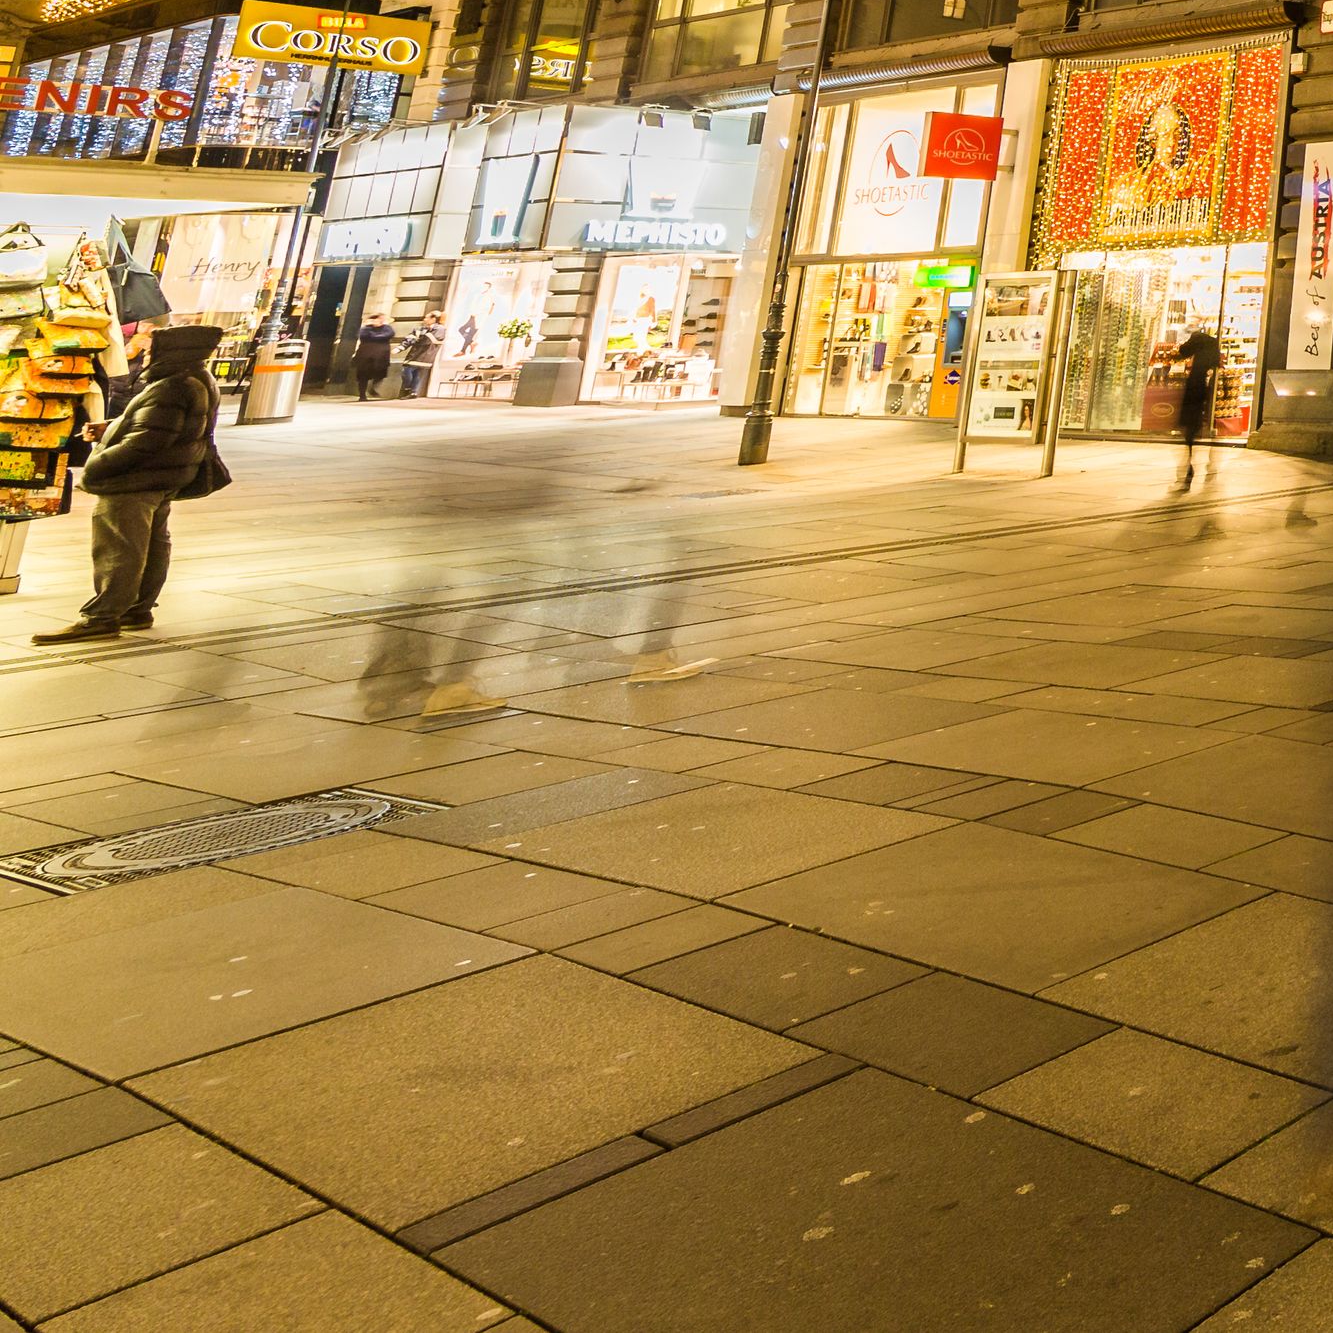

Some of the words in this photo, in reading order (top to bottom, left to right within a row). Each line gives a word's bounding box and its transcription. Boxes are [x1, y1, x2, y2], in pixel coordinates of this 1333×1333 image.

[249, 21, 421, 65] CORSO
[291, 53, 373, 66] HERRNHUERHAUS
[0, 76, 193, 121] ENIRS
[932, 149, 993, 162] SHOETASTIC
[853, 183, 930, 206] SHOETASTIC
[586, 219, 727, 246] MEPHISTO
[1311, 178, 1332, 280] AUSTRIA
[190, 257, 261, 282] Henry
[1306, 285, 1327, 306] of
[1304, 318, 1321, 357] Bes
